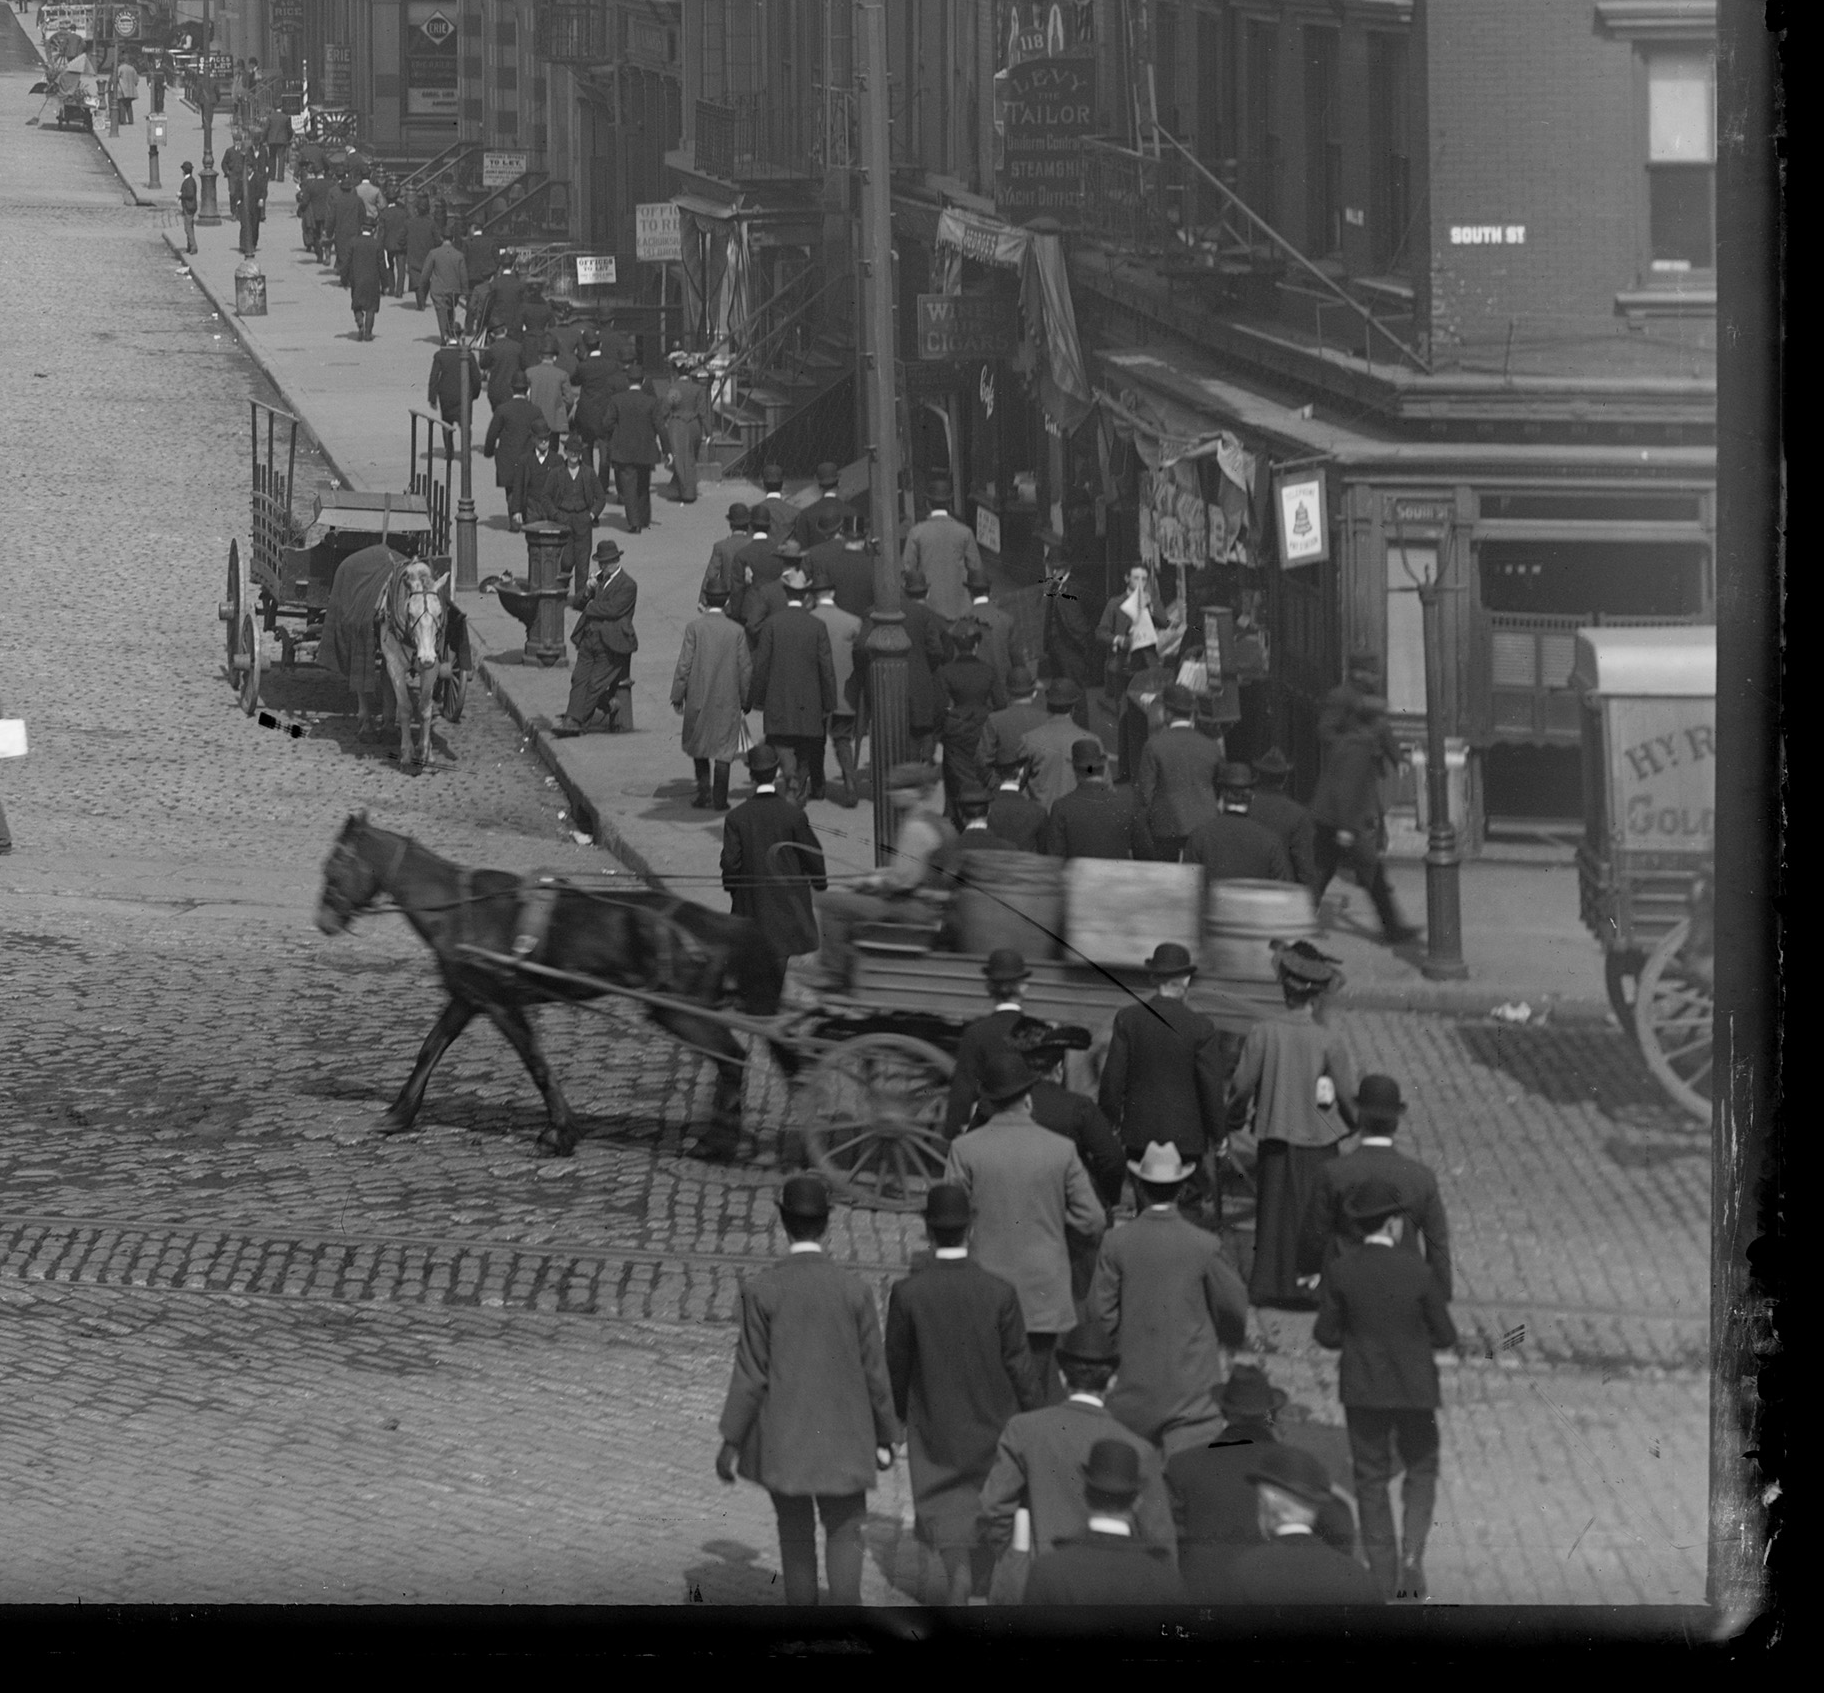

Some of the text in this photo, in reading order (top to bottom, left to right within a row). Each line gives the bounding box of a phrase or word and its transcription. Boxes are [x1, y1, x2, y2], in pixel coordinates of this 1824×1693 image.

[275, 7, 303, 17] RICE
[429, 22, 447, 34] ERIE
[1020, 33, 1044, 51] 118
[327, 48, 351, 62] ERIE
[1012, 68, 1089, 93] LEVY
[1003, 101, 1091, 125] TAILOR
[640, 219, 658, 232] TO
[1451, 225, 1502, 244] SOUTH
[578, 258, 614, 267] OFFICES
[926, 331, 1009, 353] CIGARS
